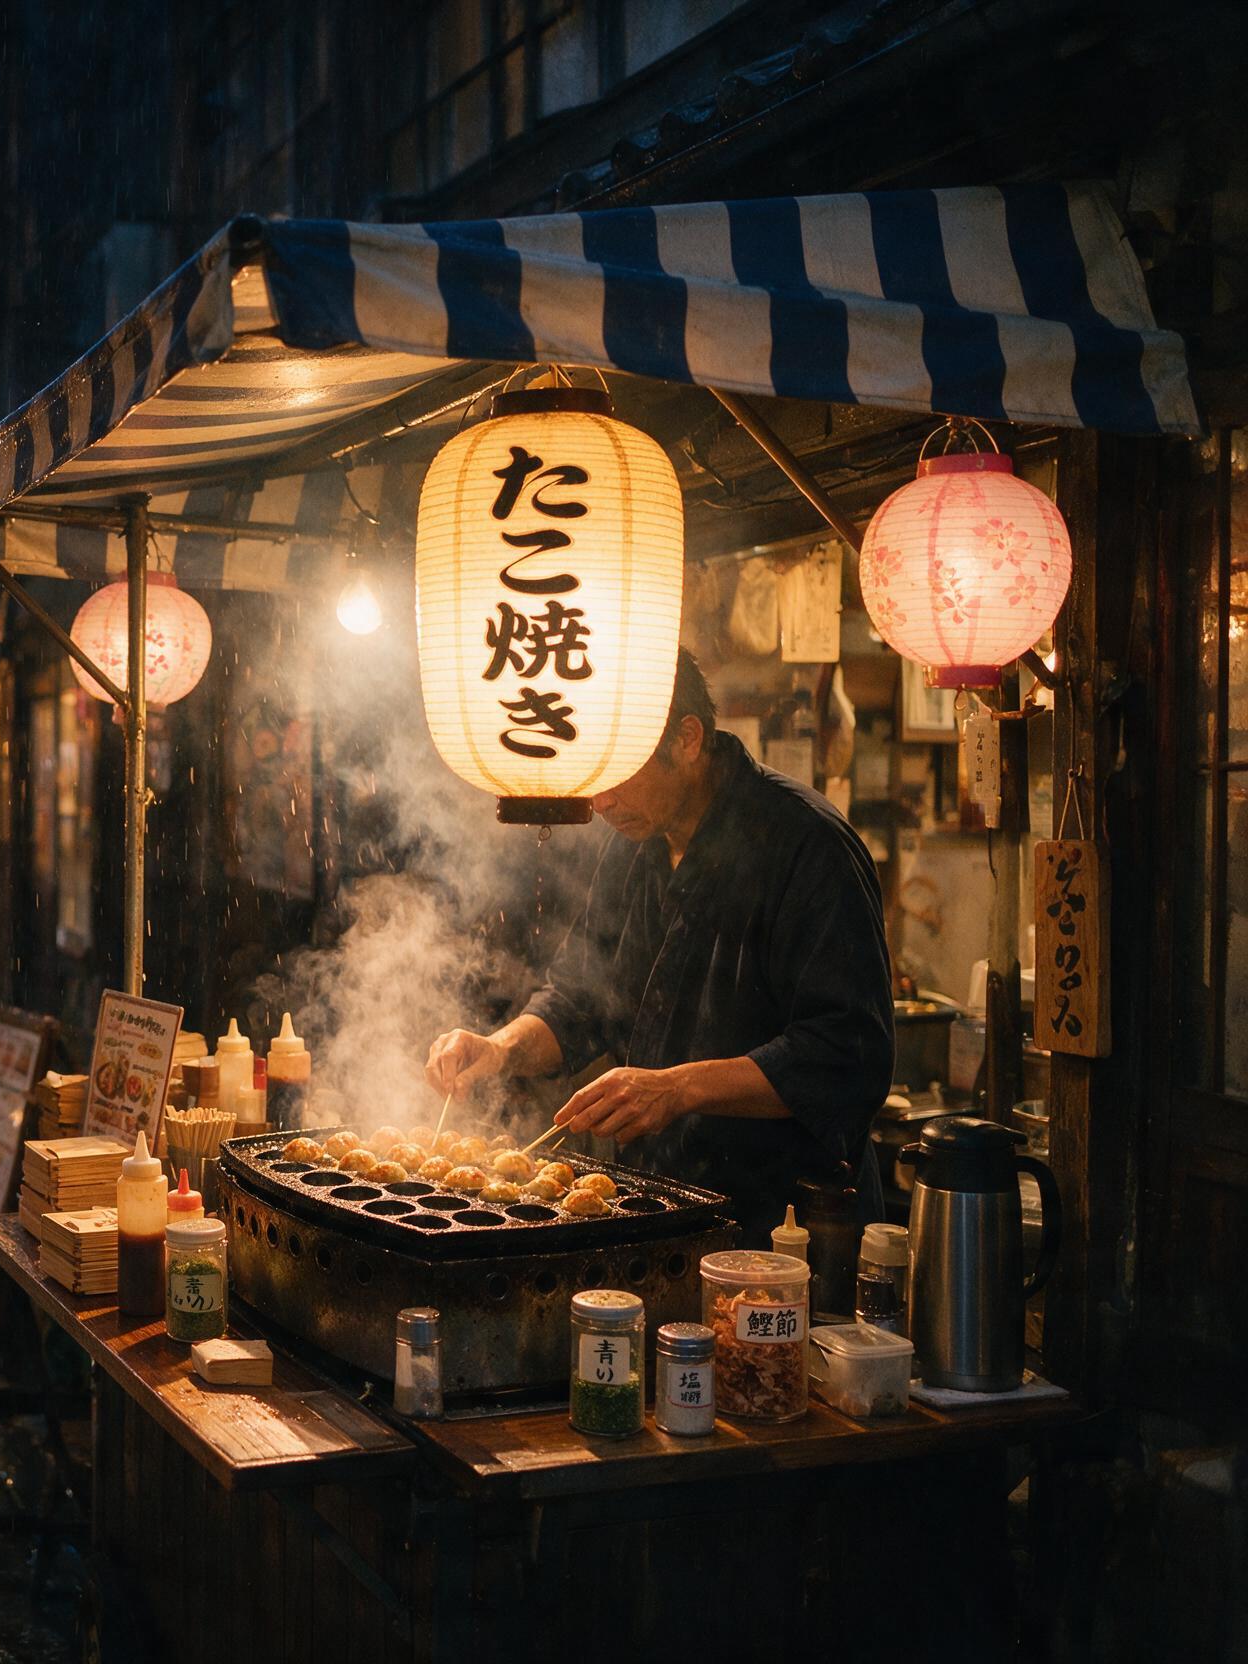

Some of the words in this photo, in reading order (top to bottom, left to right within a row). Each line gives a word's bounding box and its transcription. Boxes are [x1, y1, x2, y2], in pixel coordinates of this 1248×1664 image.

[482, 446, 592, 758] たこ焼き
[747, 1309, 796, 1337] 鰹節
